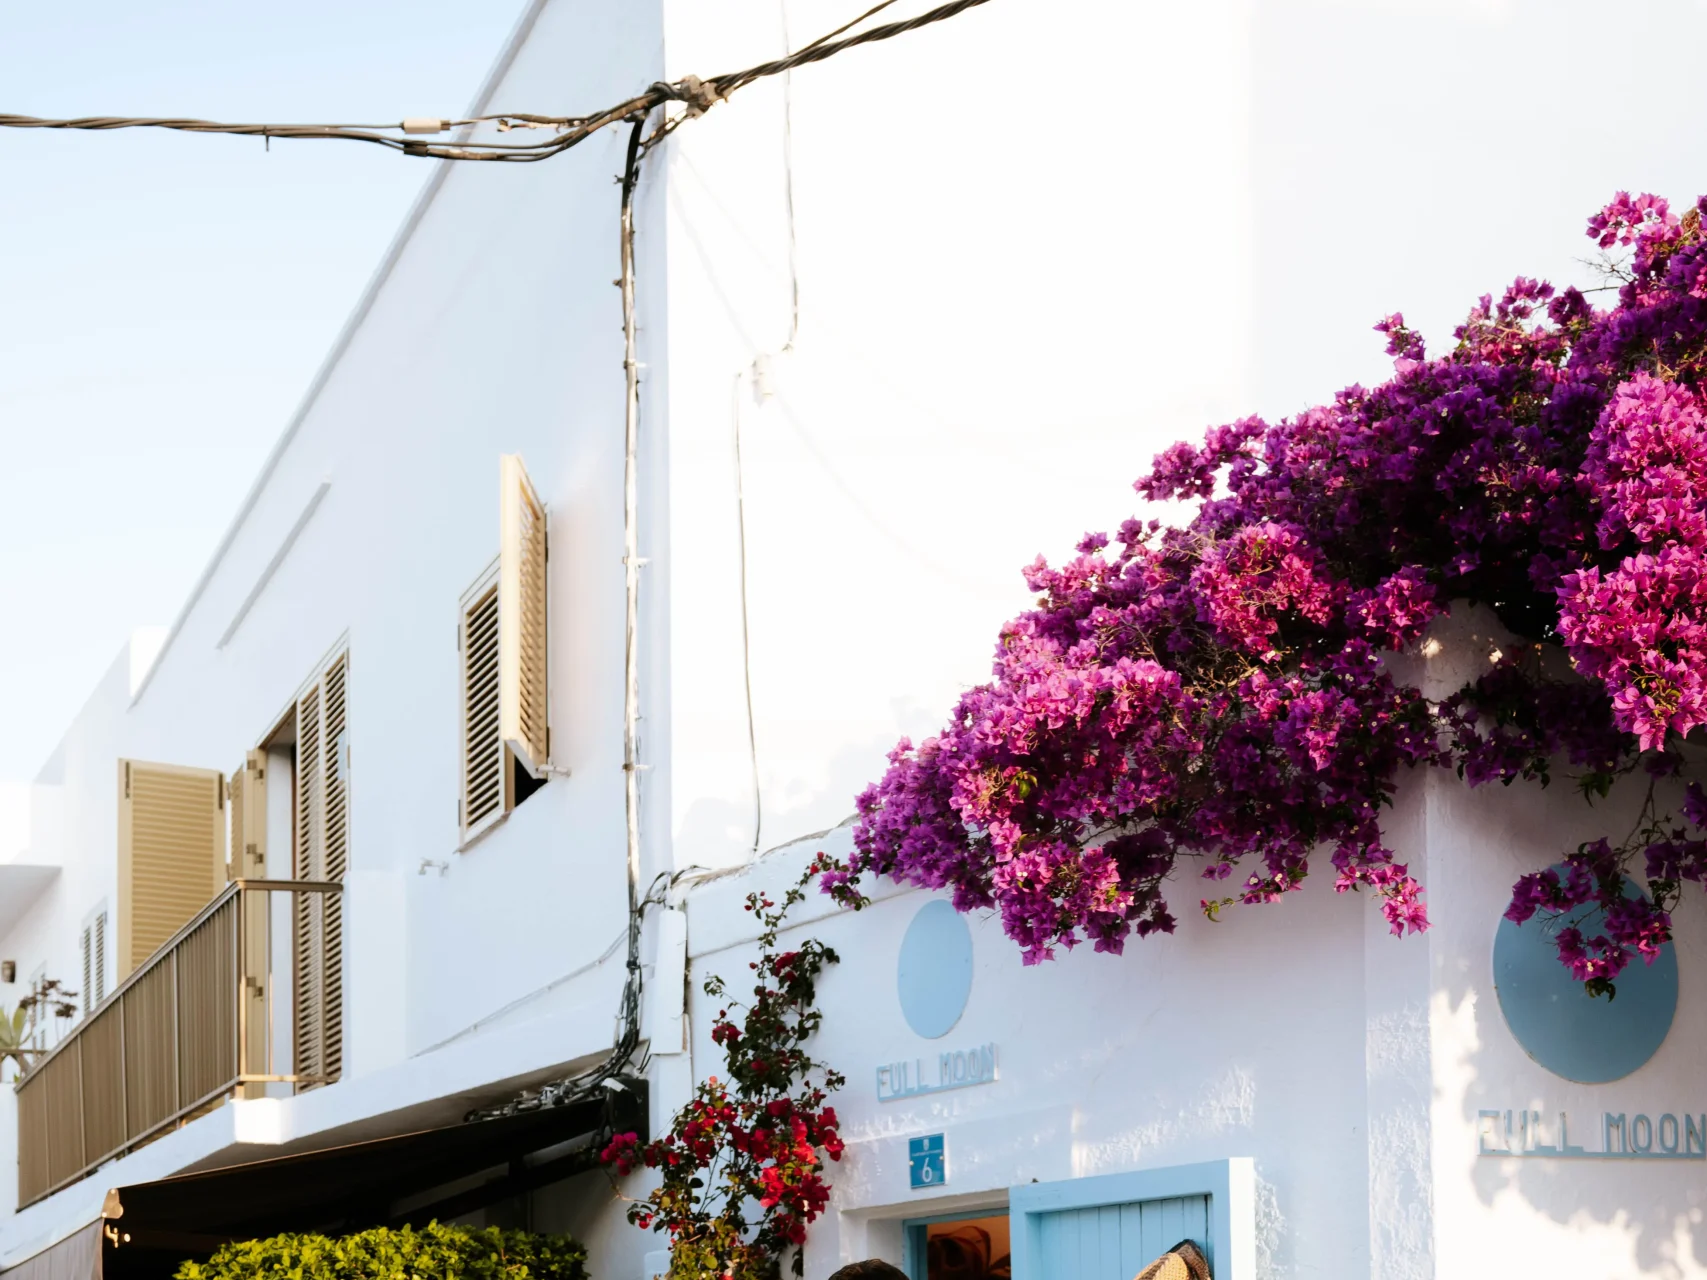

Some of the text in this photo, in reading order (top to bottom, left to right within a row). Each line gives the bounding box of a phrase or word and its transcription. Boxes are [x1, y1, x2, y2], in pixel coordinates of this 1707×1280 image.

[876, 1042, 998, 1102] FULL MOON
[1478, 1109, 1706, 1157] FULL MOON
[922, 1157, 933, 1183] 6
